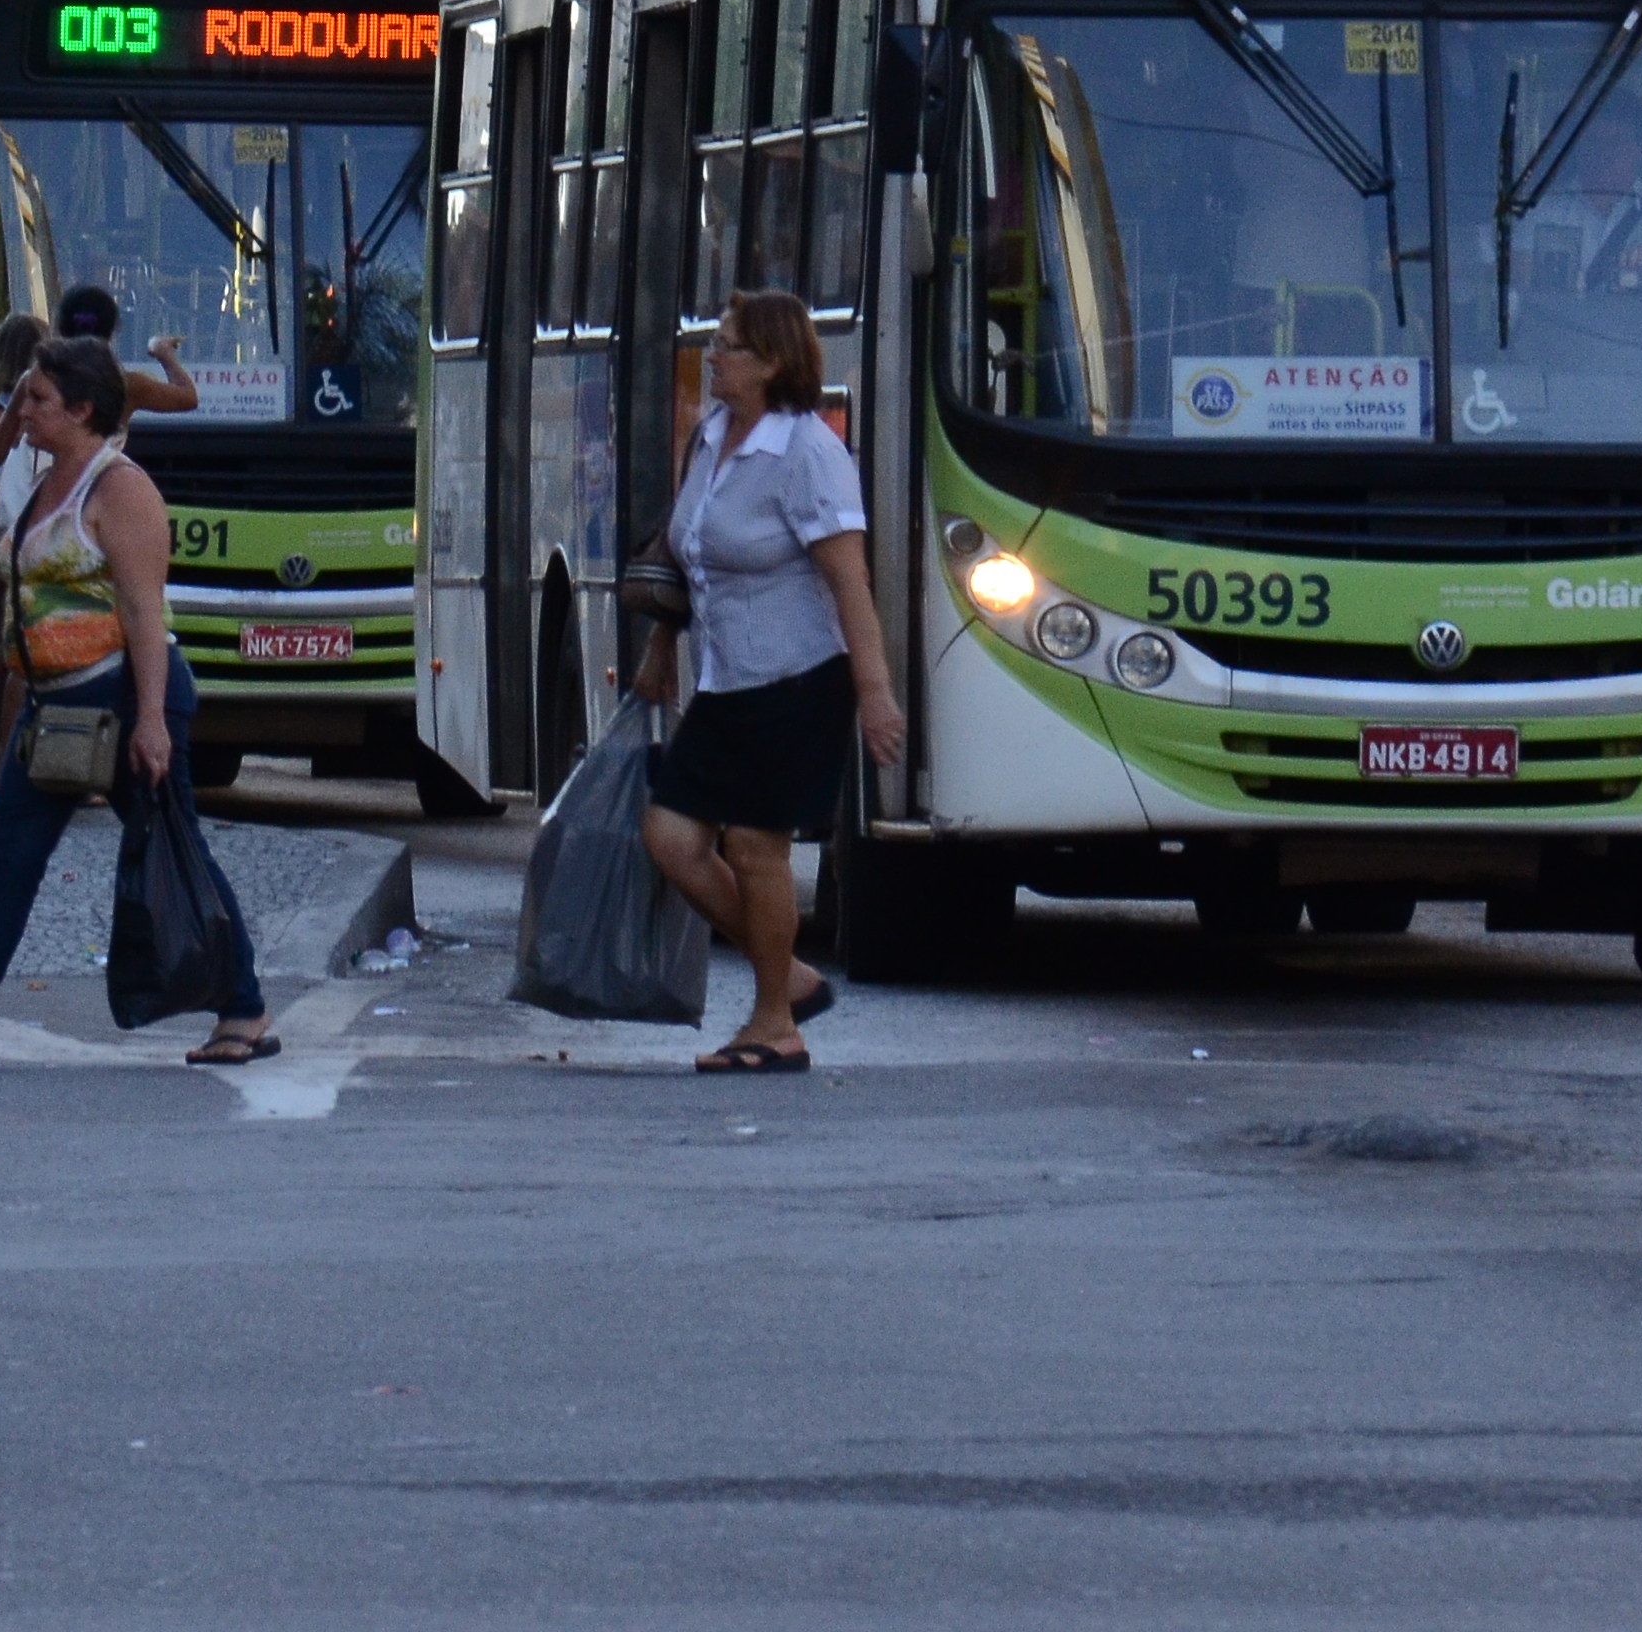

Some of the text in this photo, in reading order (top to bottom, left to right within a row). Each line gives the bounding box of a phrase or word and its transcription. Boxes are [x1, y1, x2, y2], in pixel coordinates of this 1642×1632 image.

[60, 6, 439, 58] 003 RODOVIAR
[1265, 363, 1409, 391] ATENÇÃO
[1267, 419, 1307, 431] antes
[1335, 418, 1406, 433] embarque
[1148, 568, 1331, 627] 50393
